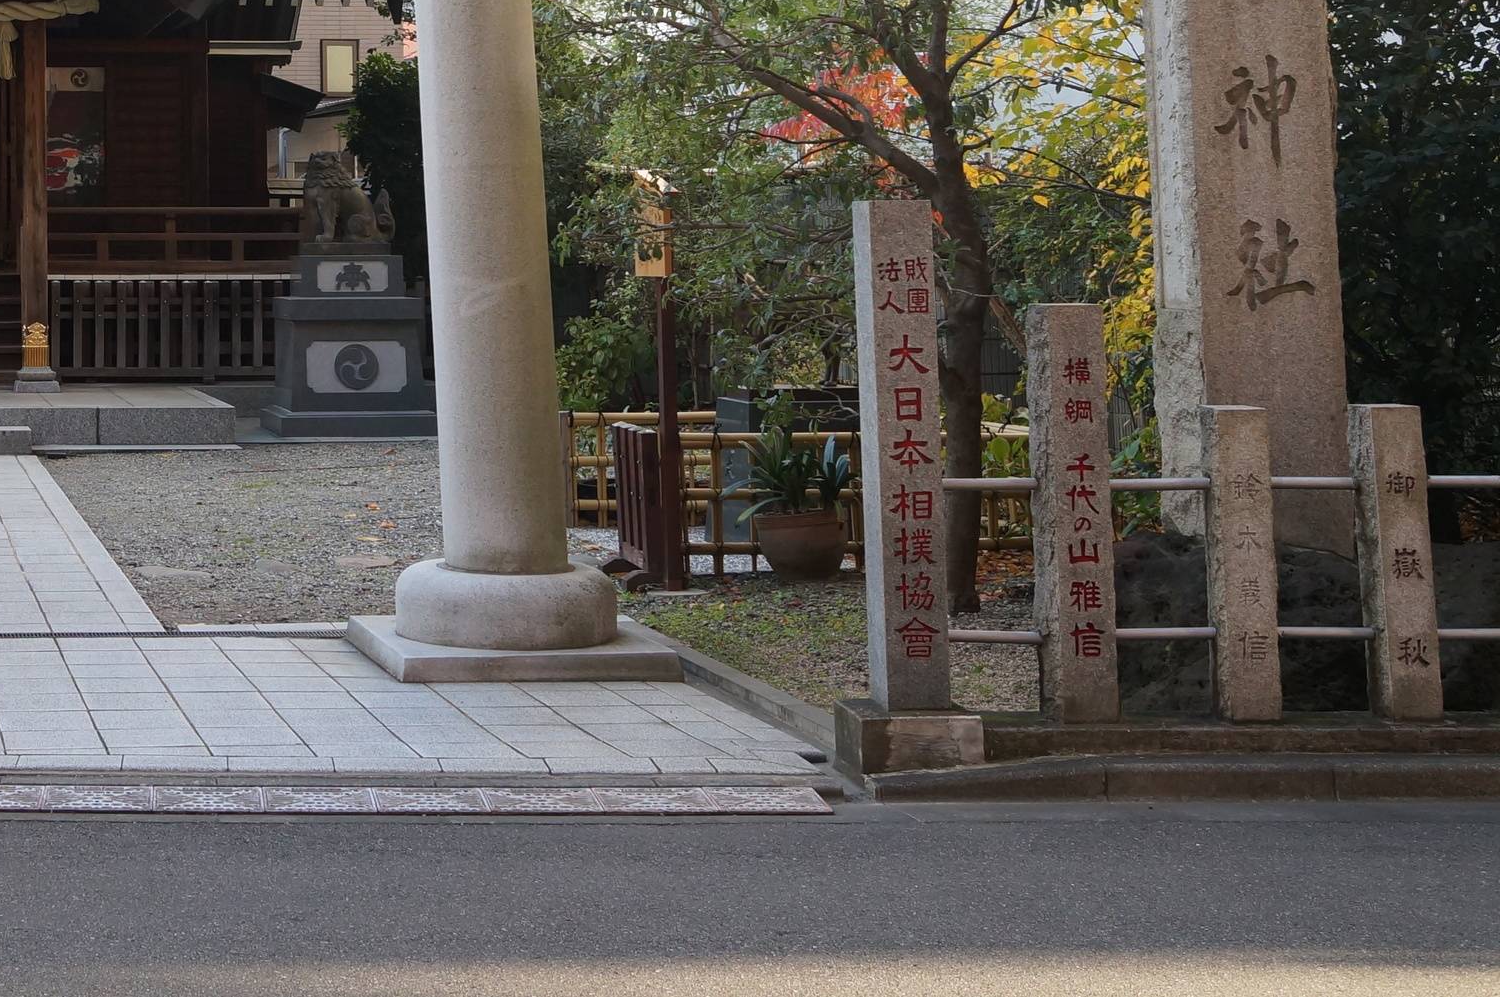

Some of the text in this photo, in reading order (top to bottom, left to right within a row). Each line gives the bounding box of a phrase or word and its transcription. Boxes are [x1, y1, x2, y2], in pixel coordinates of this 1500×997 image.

[876, 257, 906, 314] 法人
[888, 334, 940, 659] 大日本相撲協會
[1228, 472, 1269, 661] 鈴木義信
